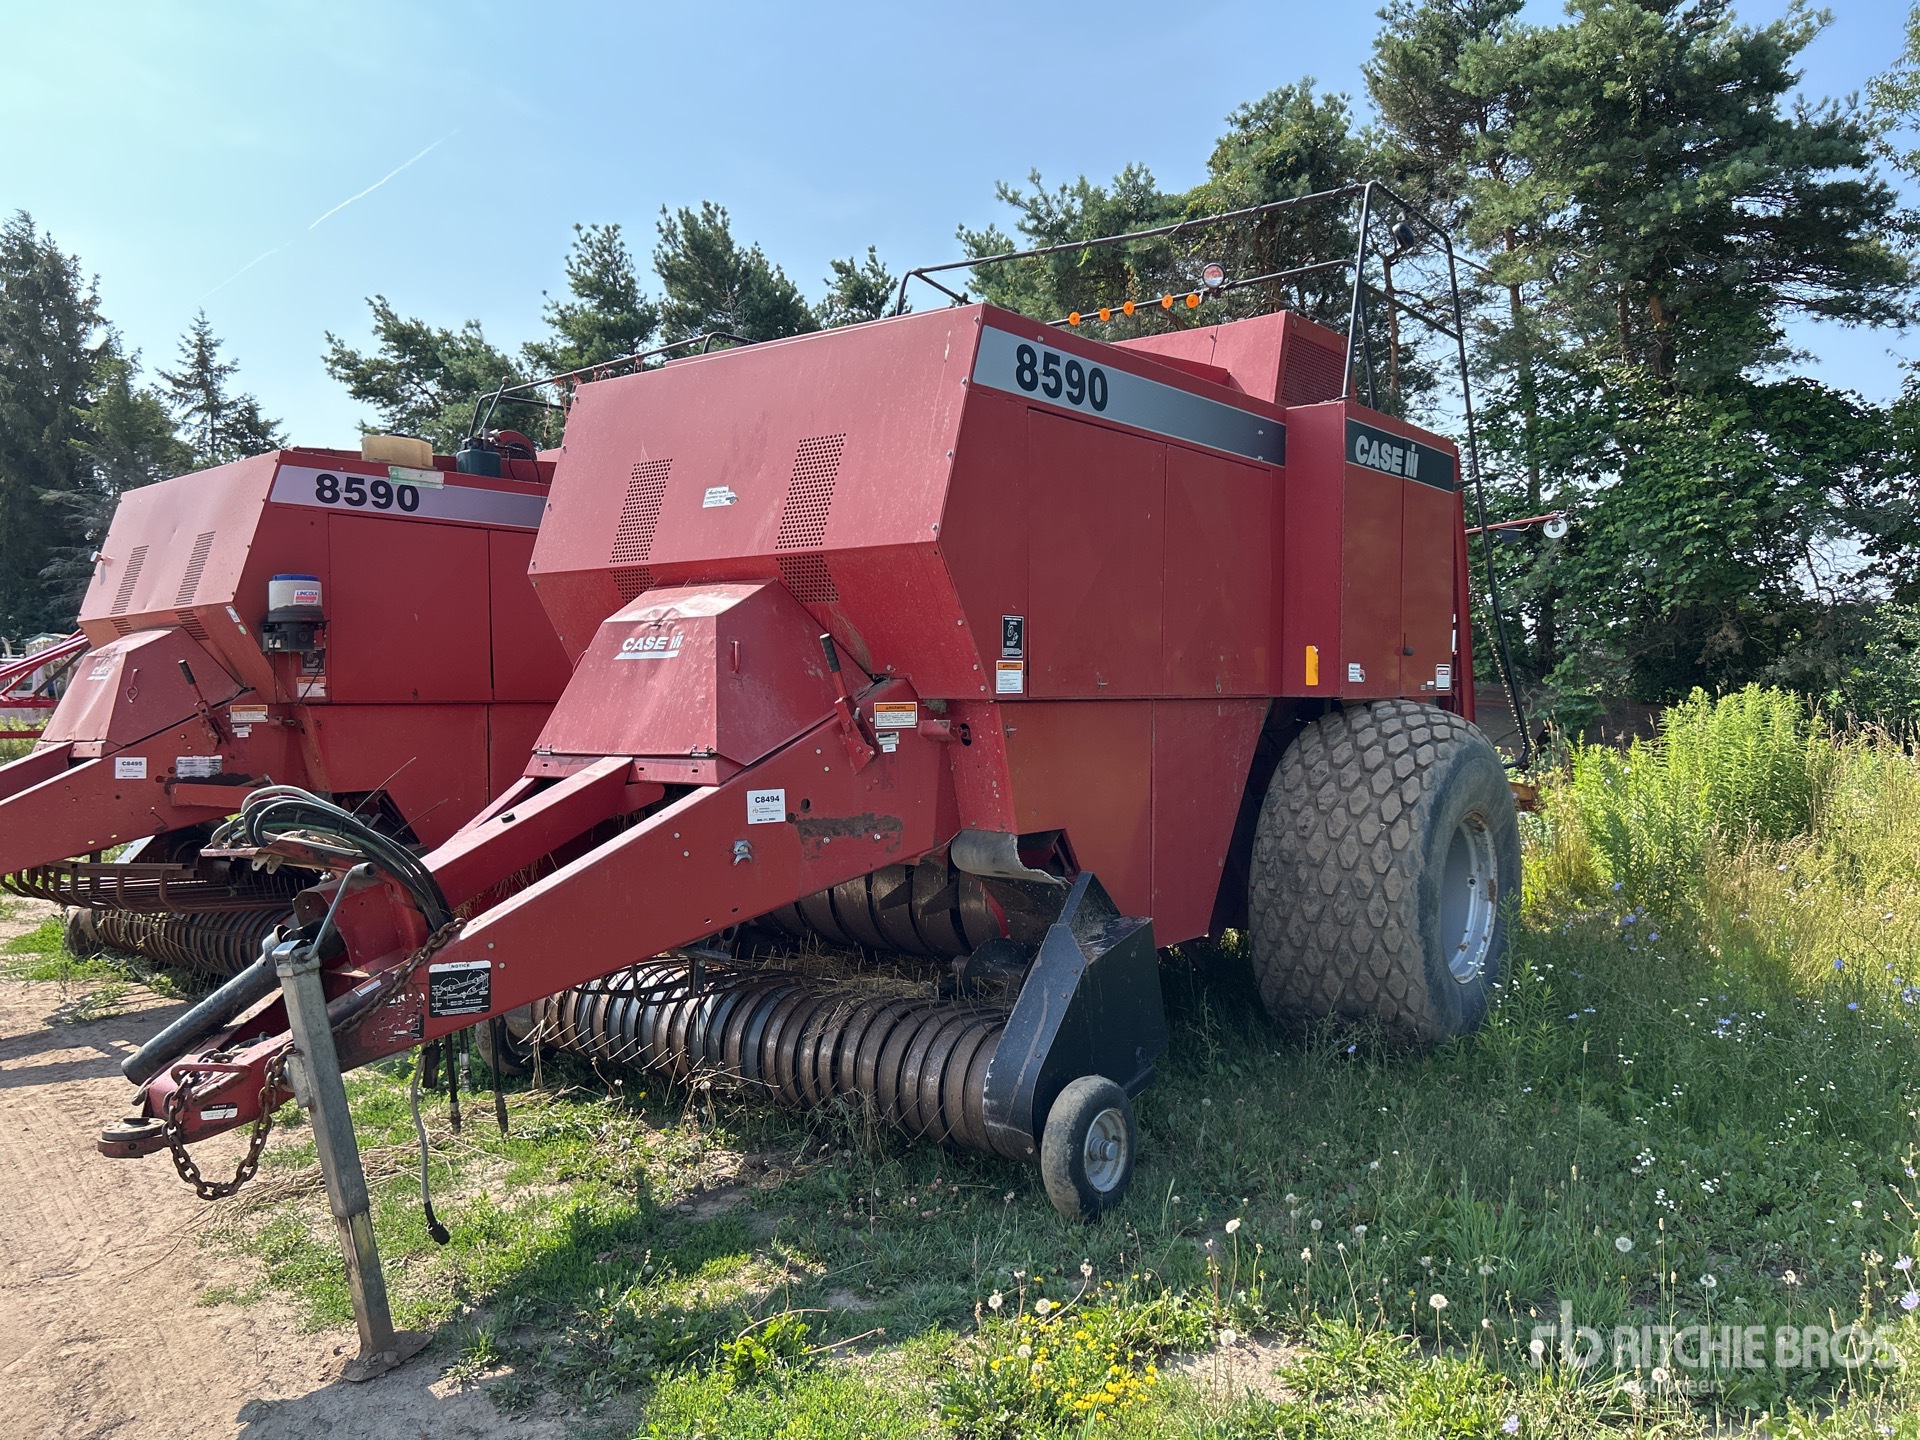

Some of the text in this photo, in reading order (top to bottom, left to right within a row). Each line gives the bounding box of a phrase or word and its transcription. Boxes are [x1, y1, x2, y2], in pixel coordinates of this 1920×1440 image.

[1016, 343, 1108, 411] 8590
[1355, 435, 1403, 474] CASE
[315, 473, 420, 512] 8590
[622, 636, 669, 651] CASE
[755, 795, 780, 803] C8494
